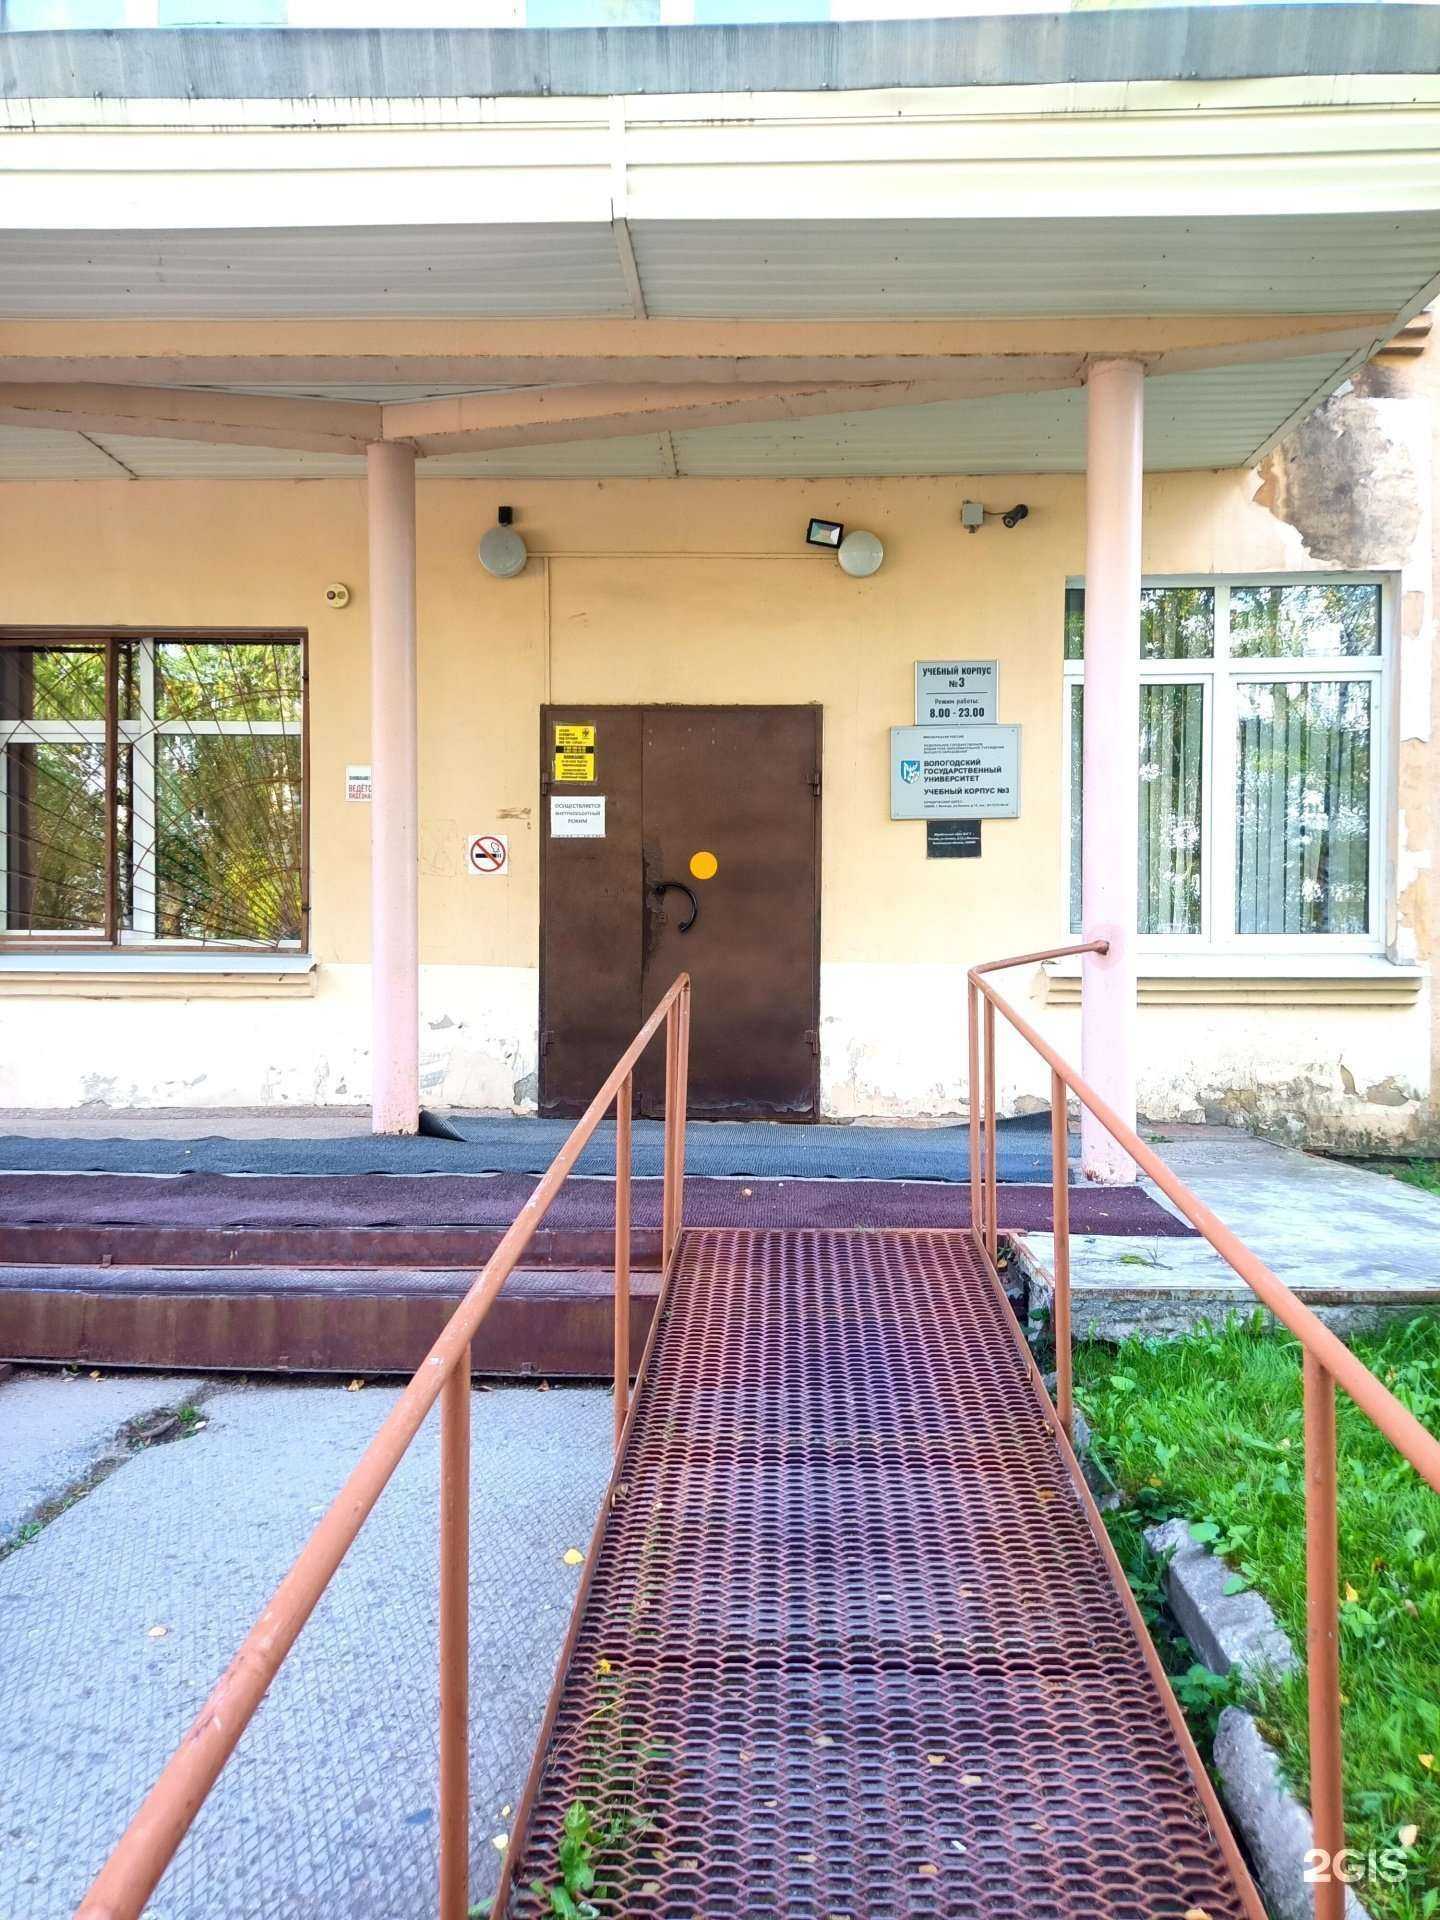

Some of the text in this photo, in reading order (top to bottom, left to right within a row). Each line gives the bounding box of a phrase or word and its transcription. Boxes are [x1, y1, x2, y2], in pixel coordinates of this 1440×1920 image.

[922, 666, 991, 677] УЧЕБНЫЙ КОРПУС
[929, 708, 951, 718] 8.00
[958, 707, 985, 718] 23.00
[923, 759, 981, 767] ВОЛОГОДСКИЙ
[923, 766, 1002, 775] ГОСУДАРСТВЕННЫЙ
[923, 775, 980, 783] УНИВЕРСИТЕТ
[348, 784, 372, 792] ВЕДЁТС
[923, 788, 962, 796] УЧЕБНЫЙ
[964, 787, 995, 795] КОРПУС
